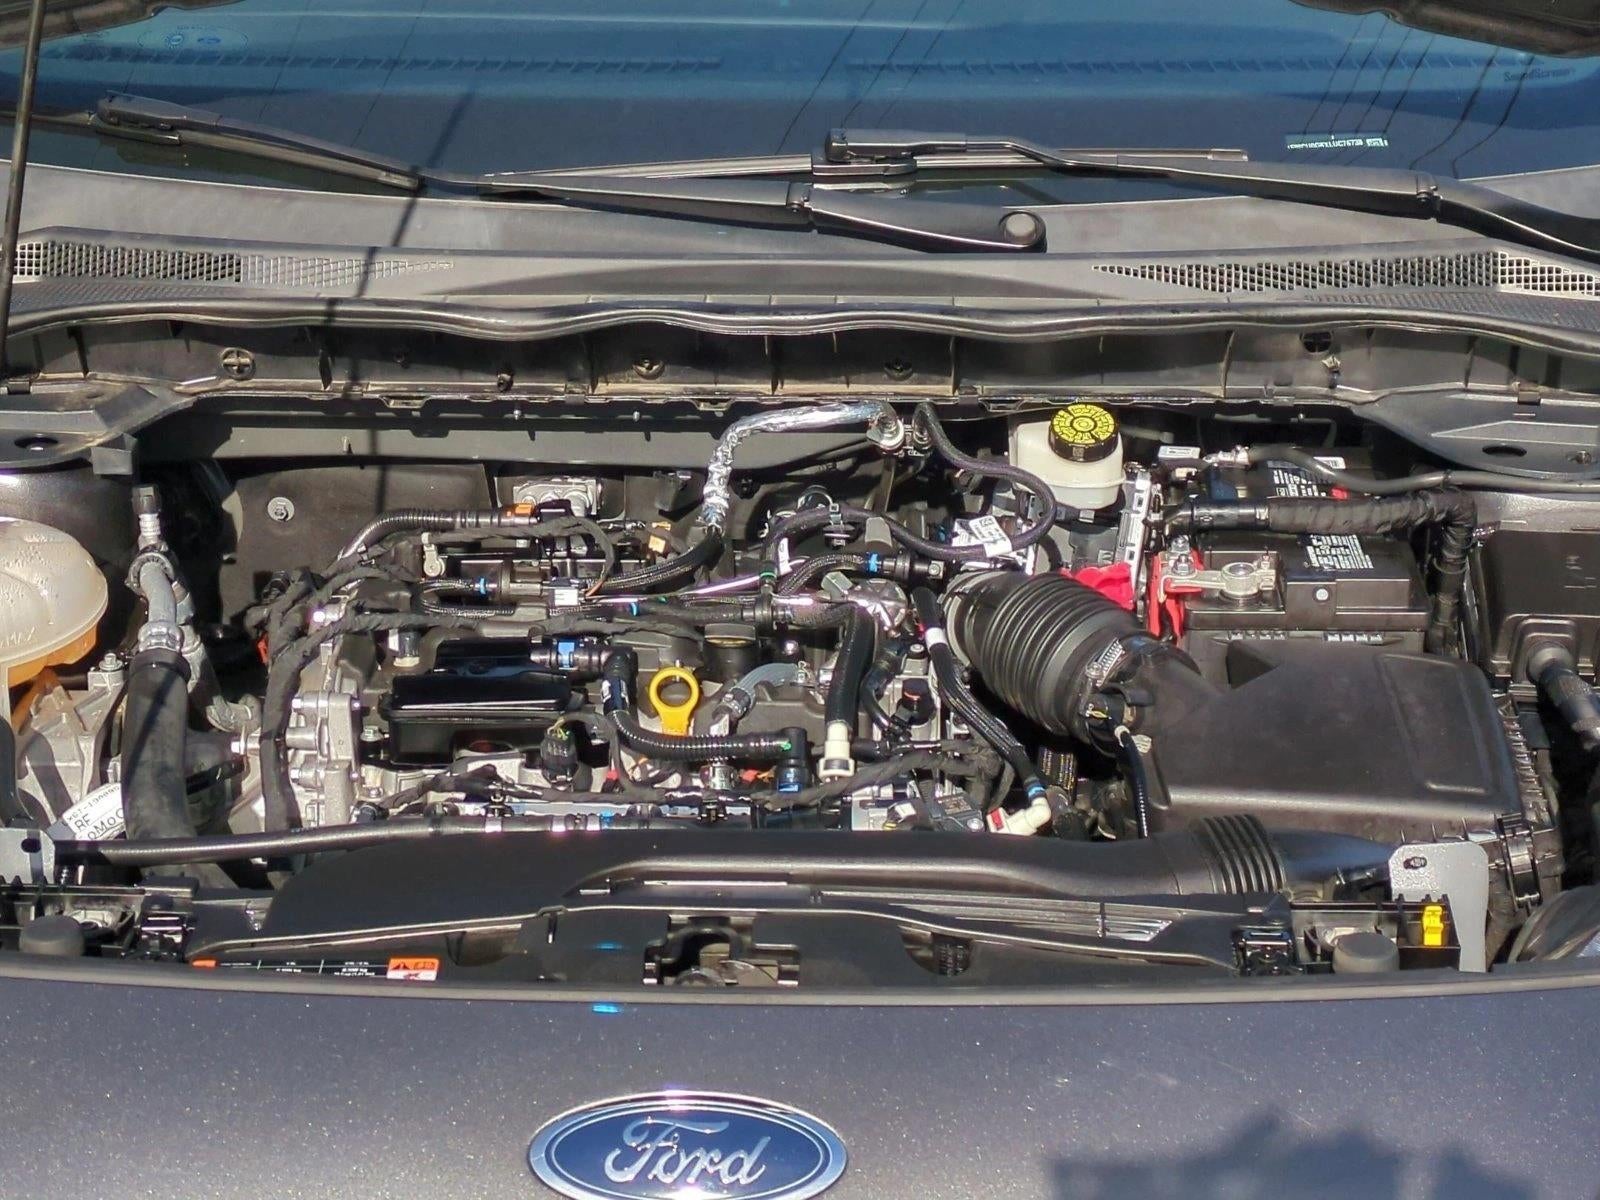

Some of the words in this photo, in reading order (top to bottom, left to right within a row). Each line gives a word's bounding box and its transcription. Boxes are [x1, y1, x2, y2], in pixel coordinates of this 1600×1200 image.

[74, 813, 90, 832] RF
[87, 807, 124, 840] oMoC
[604, 1116, 771, 1184] Ford
